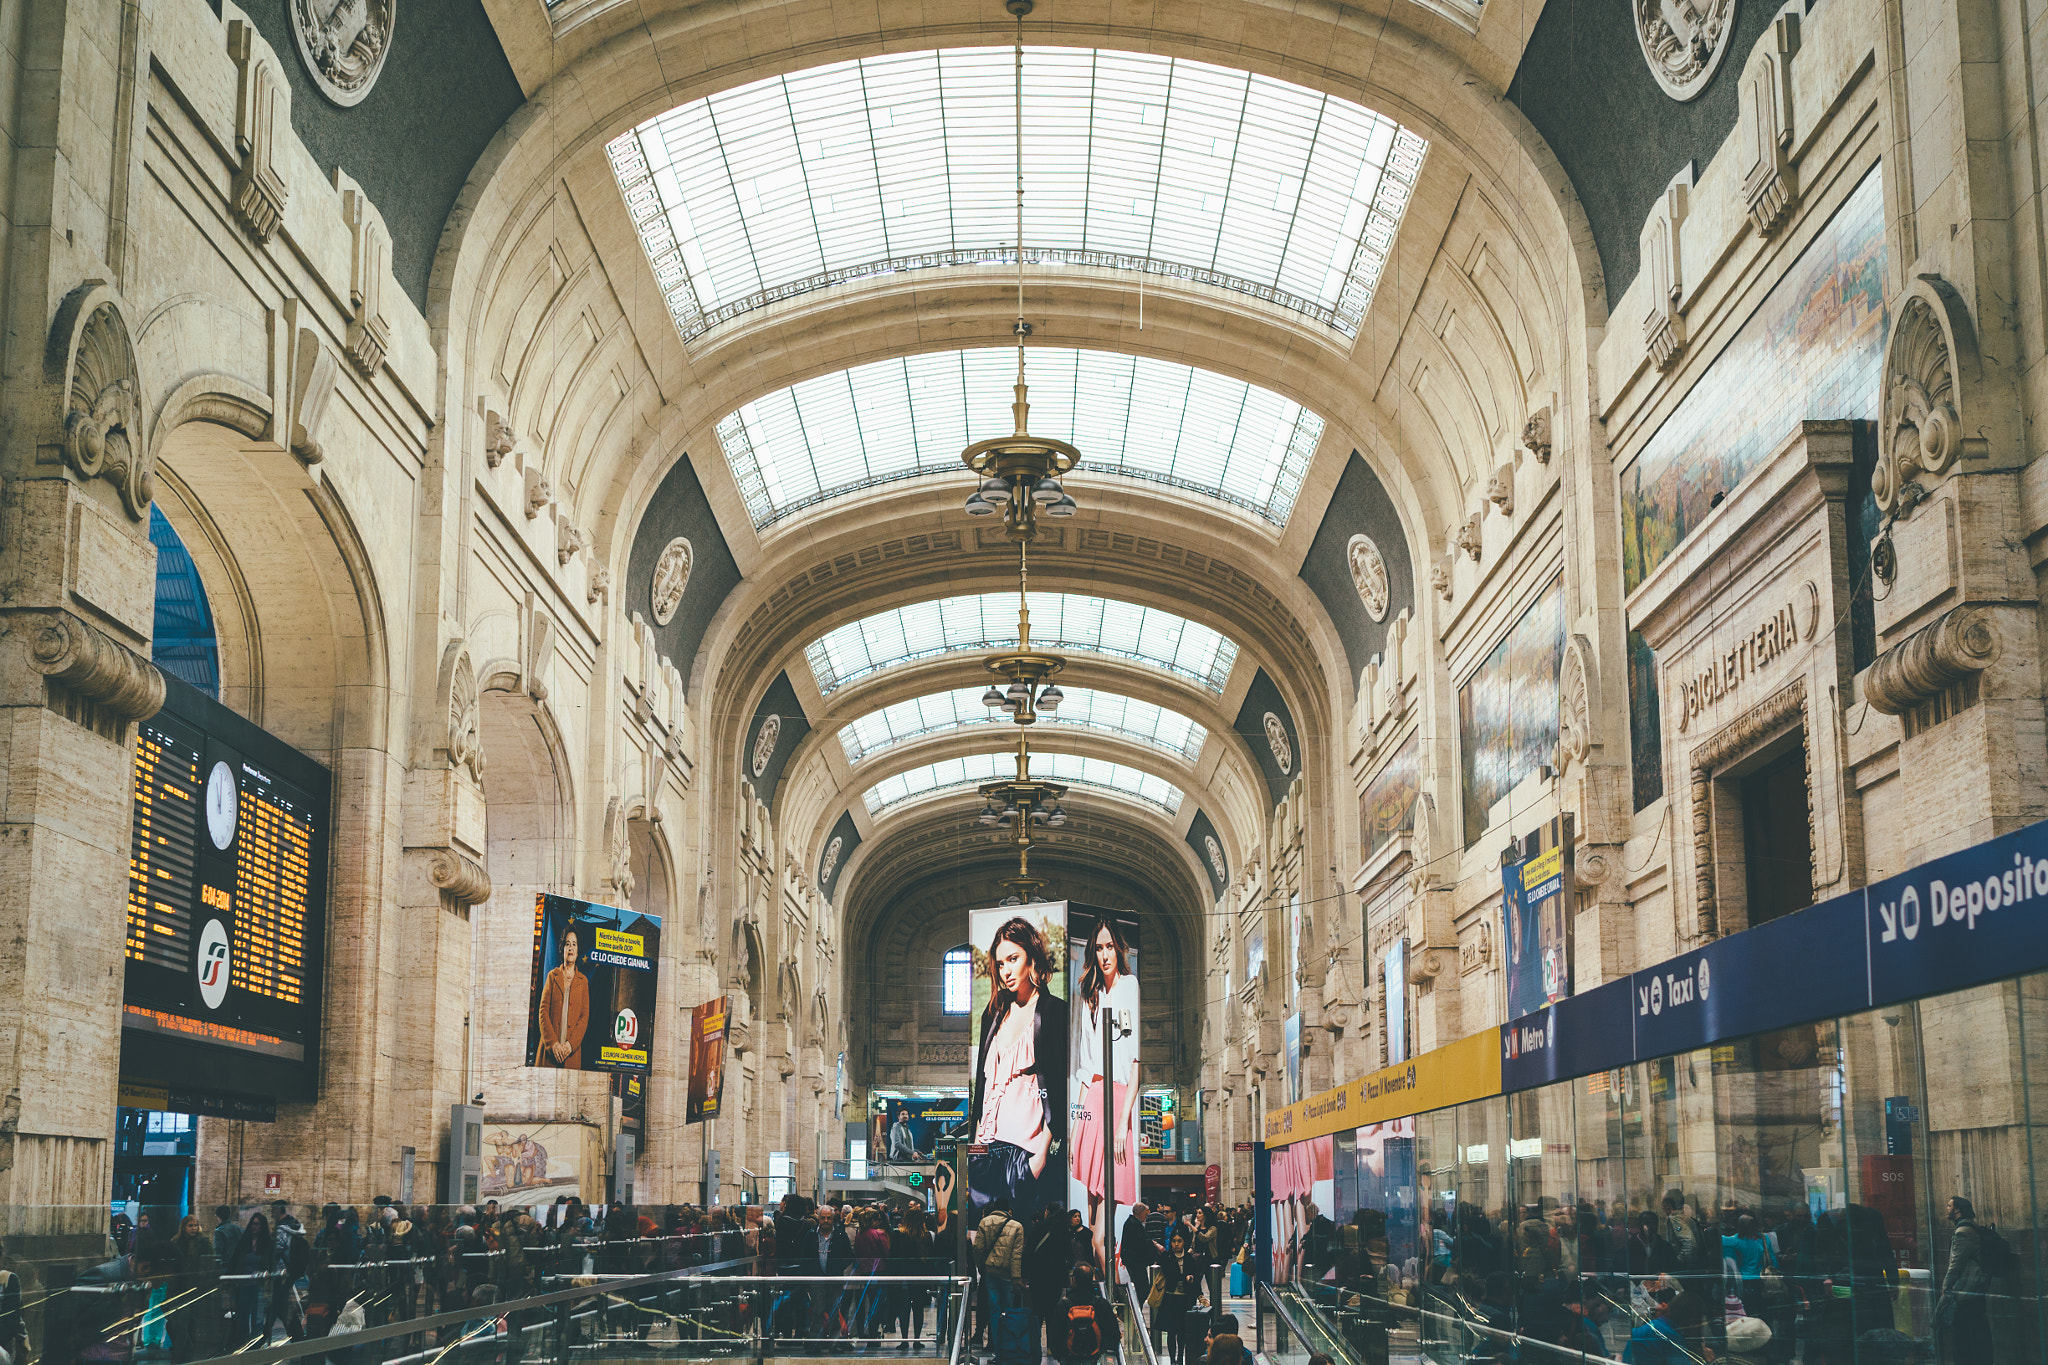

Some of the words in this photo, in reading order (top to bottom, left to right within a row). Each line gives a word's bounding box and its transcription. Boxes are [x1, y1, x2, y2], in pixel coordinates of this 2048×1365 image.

[1689, 603, 1798, 717] BIGLIETTERIA
[1536, 884, 1547, 900] CHIEDE
[1930, 852, 2048, 930] Deposito
[598, 932, 612, 940] Niente
[598, 941, 611, 949] tranne
[591, 951, 598, 960] CE
[598, 953, 606, 962] LO
[607, 954, 627, 966] CHIEDE
[628, 957, 650, 969] GIANNA.
[1667, 967, 1693, 1007] Taxi
[1521, 1027, 1544, 1053] Metro
[1367, 1082, 1378, 1100] Piazza
[1384, 1071, 1405, 1095] Novembre
[1882, 1172, 1904, 1182] SOS
